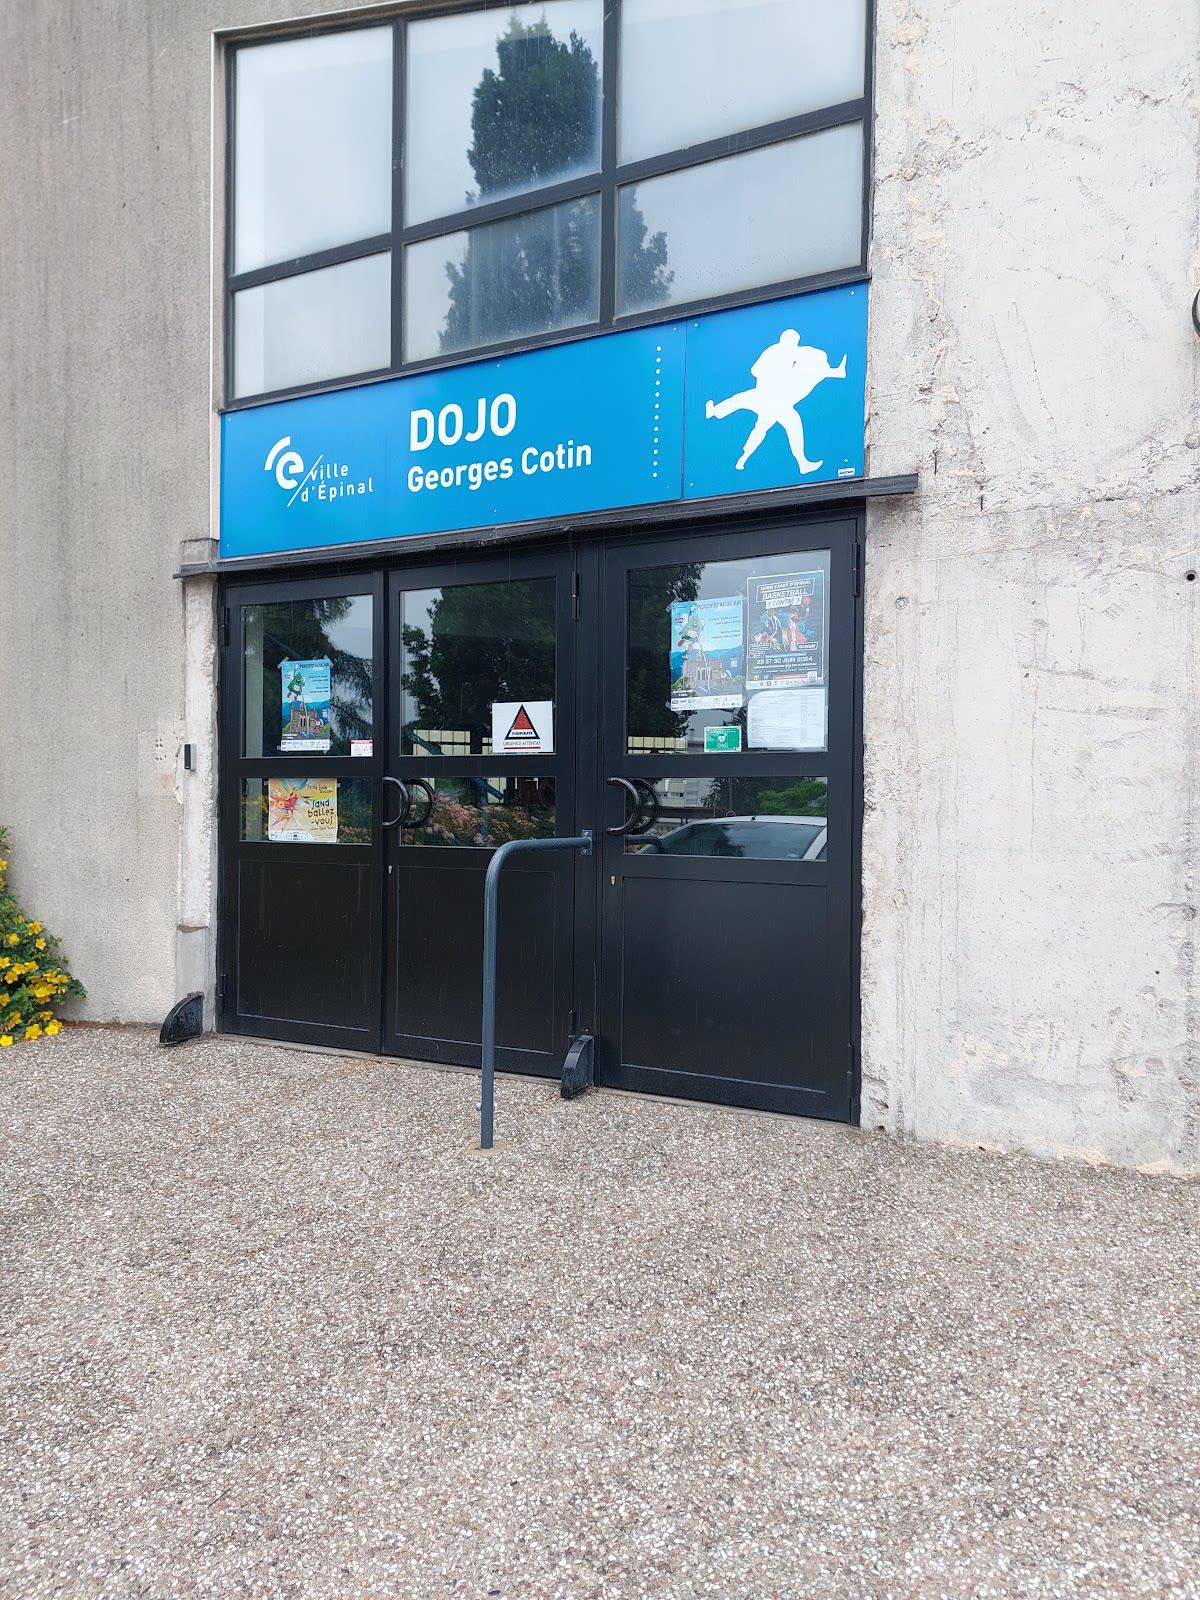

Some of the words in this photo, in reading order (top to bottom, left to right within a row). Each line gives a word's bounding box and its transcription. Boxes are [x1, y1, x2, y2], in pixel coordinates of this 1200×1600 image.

[410, 392, 517, 452] DOJO
[407, 456, 513, 493] Georges
[521, 440, 592, 475] Cotin
[301, 477, 374, 503] d'Épinal
[762, 588, 808, 600] BASKETBALL
[773, 597, 796, 607] CONTRE
[797, 655, 813, 663] 2024
